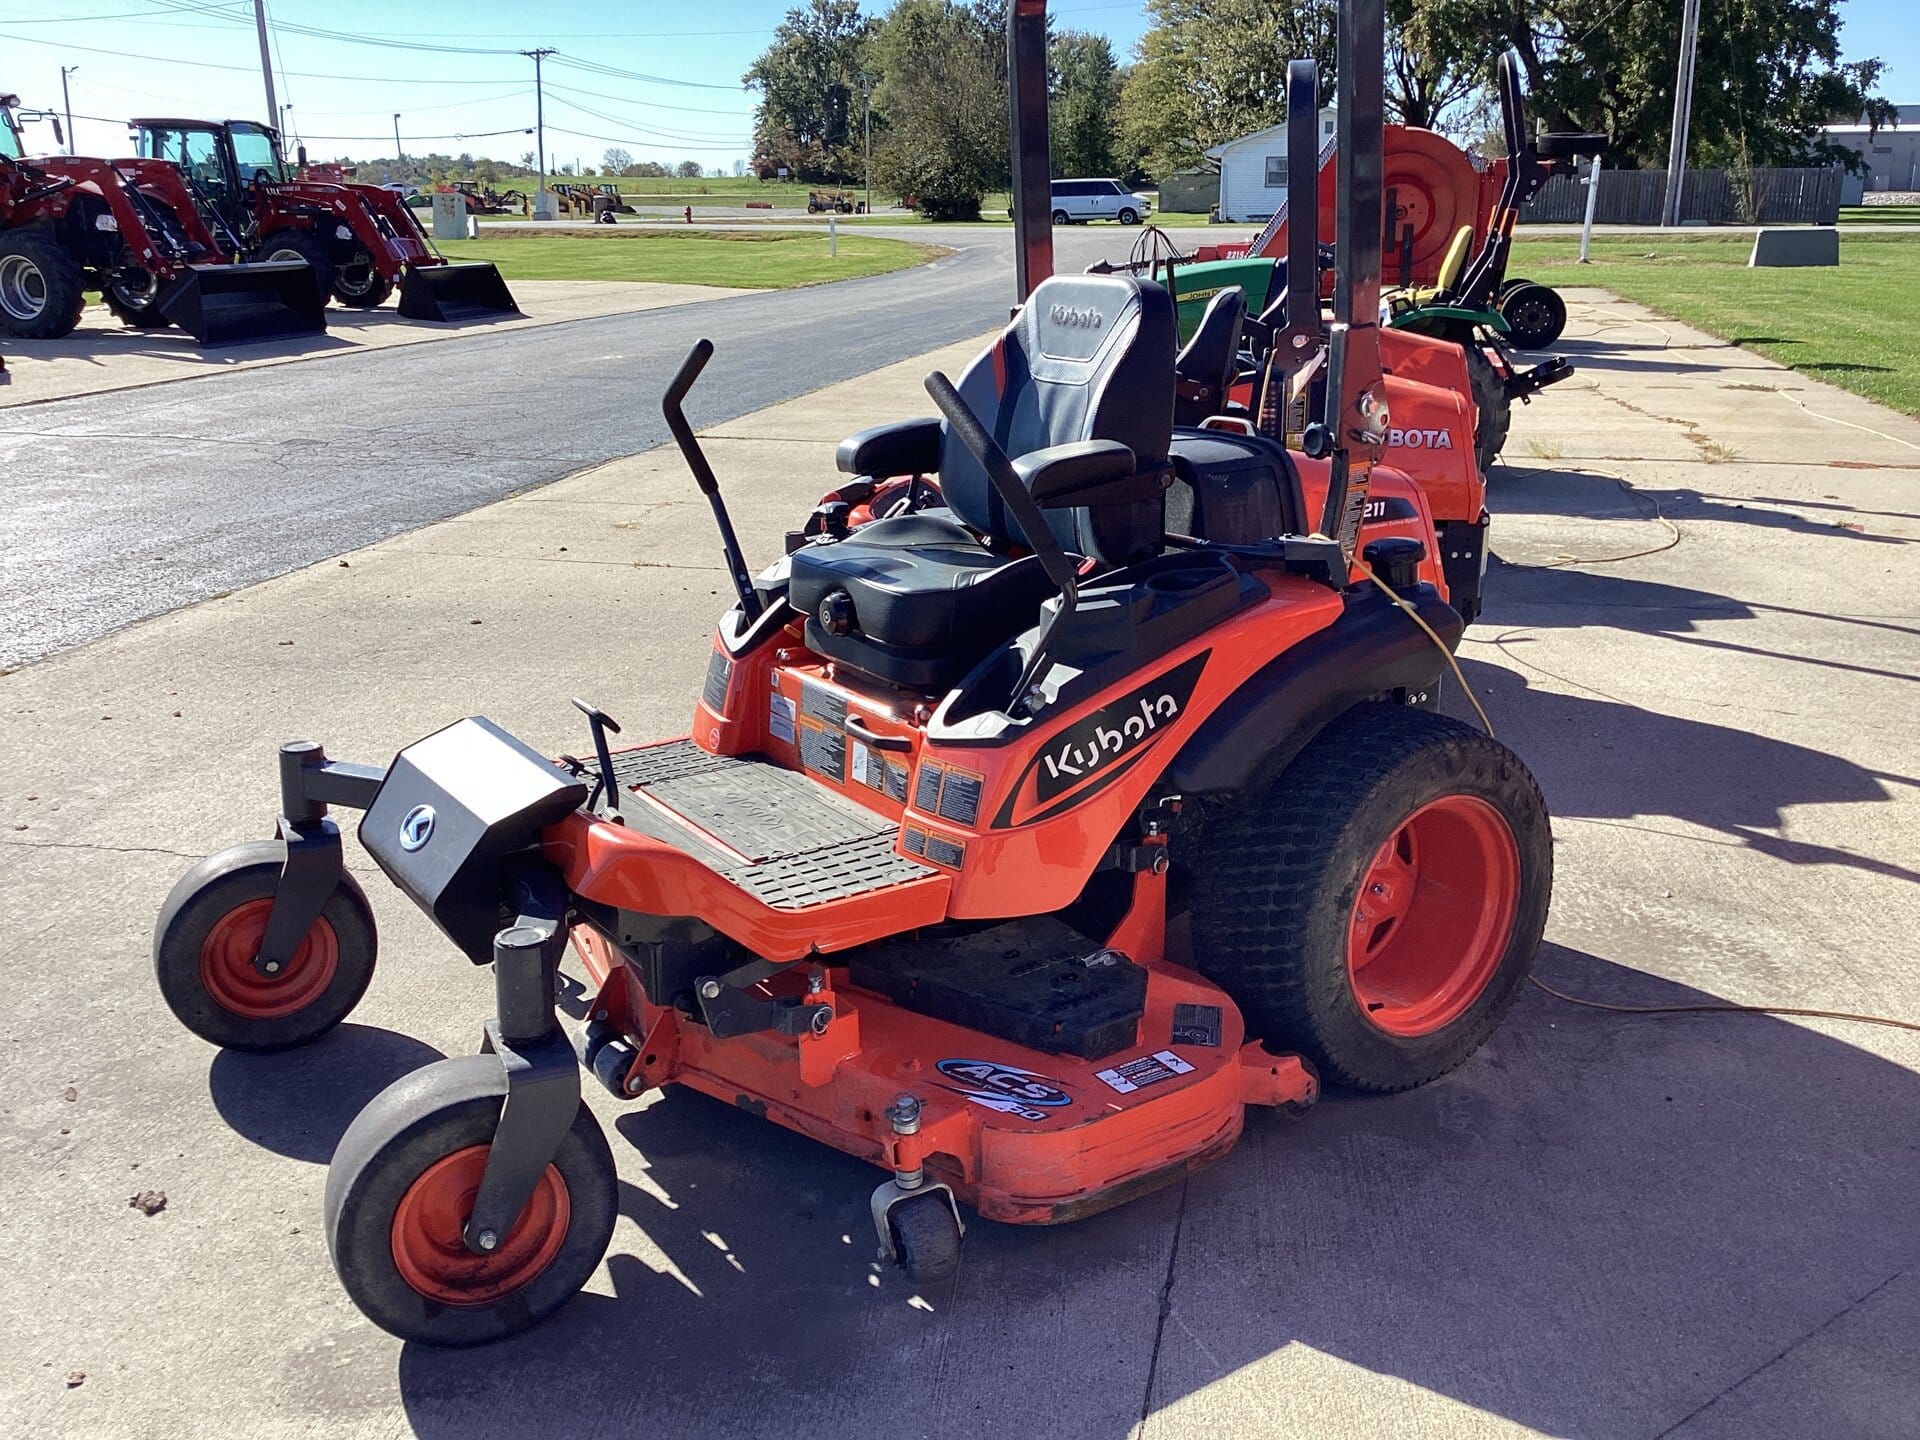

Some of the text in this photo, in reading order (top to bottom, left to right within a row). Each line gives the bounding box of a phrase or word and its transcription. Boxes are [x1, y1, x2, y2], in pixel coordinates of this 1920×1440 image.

[1189, 290, 1211, 300] JOHN
[1050, 304, 1102, 329] Kubota
[1387, 427, 1453, 449] BOTA
[1363, 501, 1386, 518] 211
[1044, 694, 1178, 779] Kubota
[953, 1065, 1059, 1099] ACS
